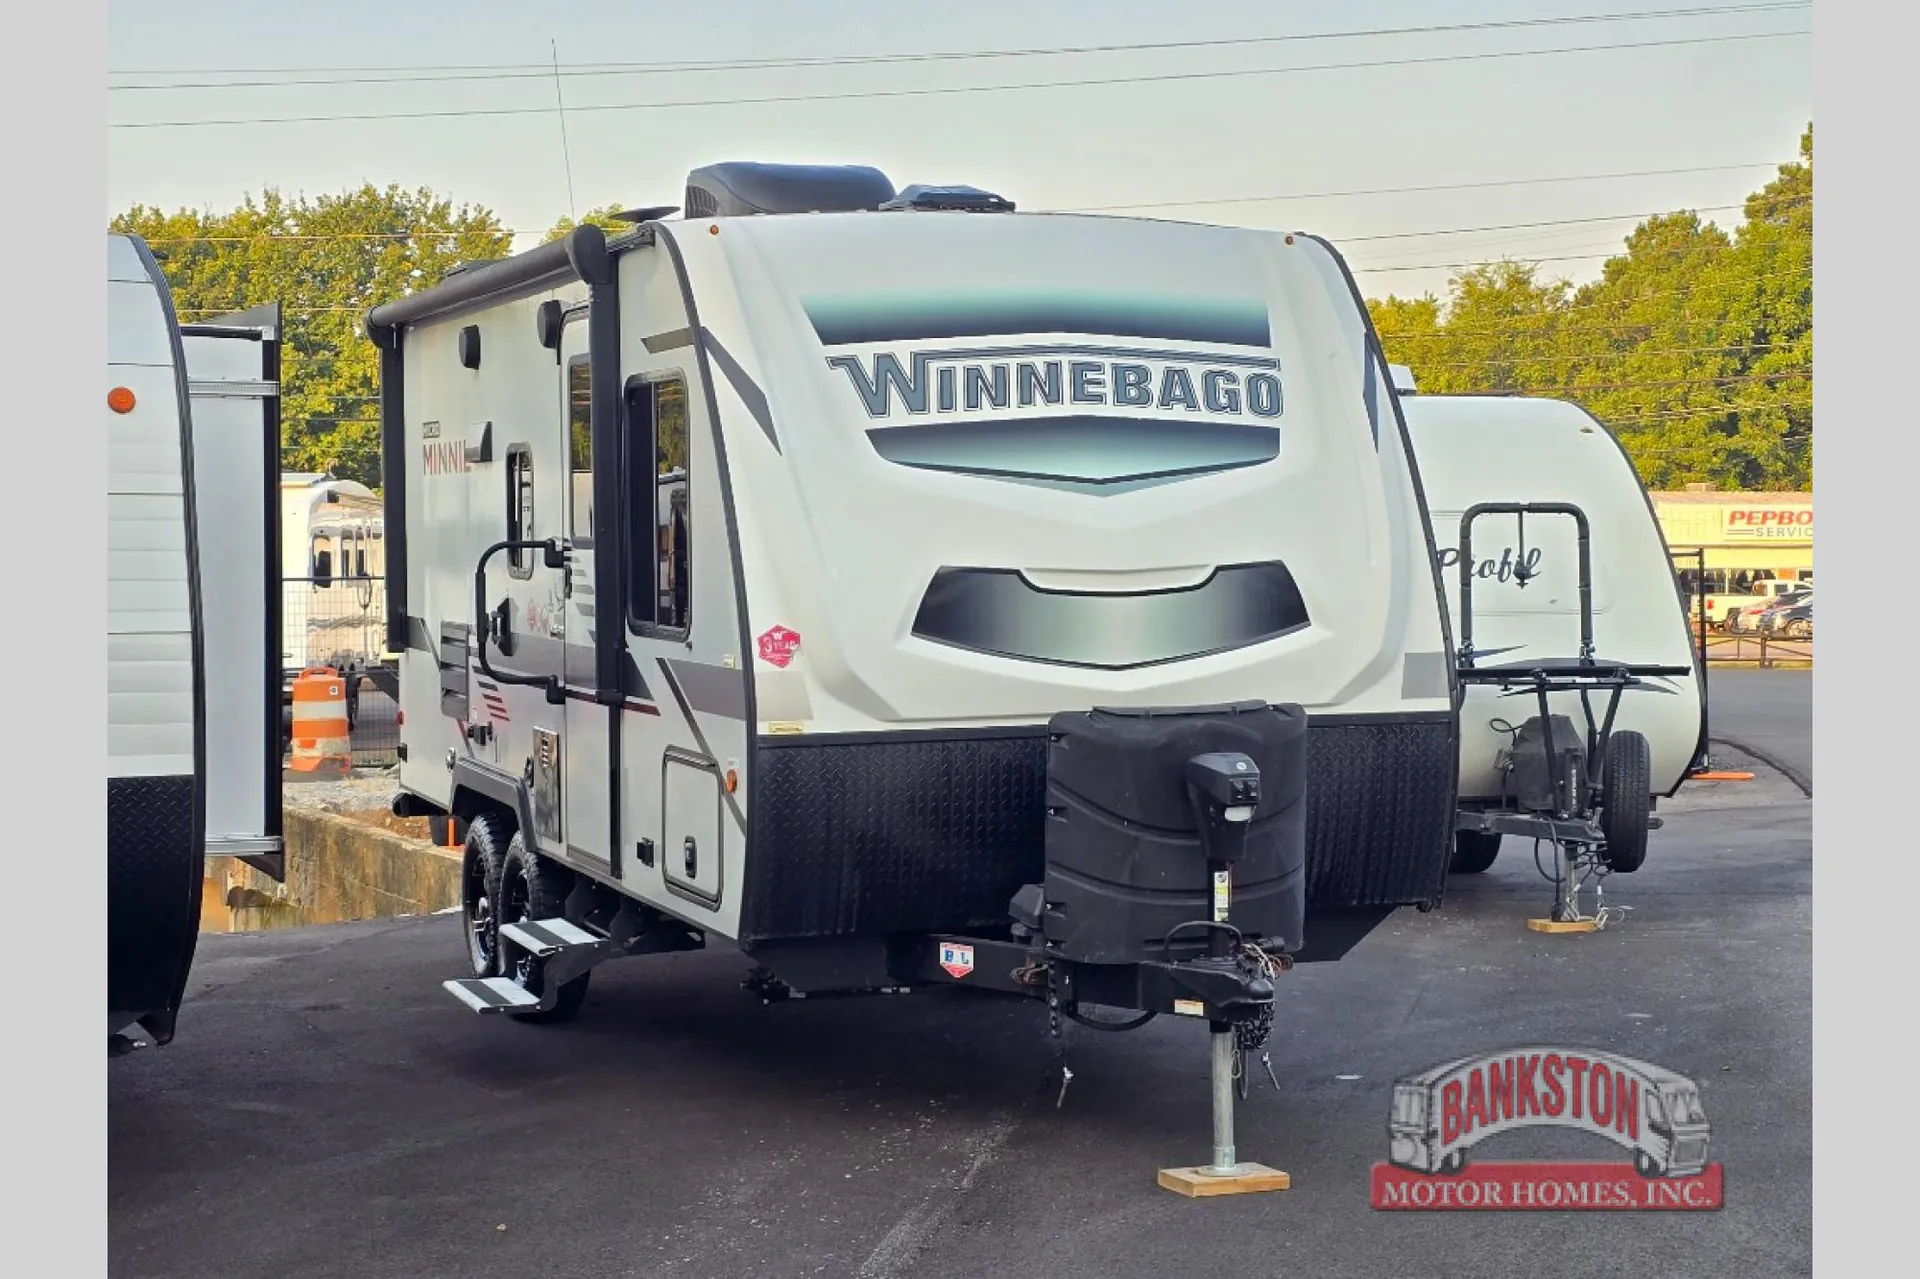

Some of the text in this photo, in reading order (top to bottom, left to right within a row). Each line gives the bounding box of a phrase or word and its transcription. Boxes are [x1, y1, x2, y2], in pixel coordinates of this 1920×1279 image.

[825, 343, 1284, 418] WINNEBAGO
[1728, 510, 1813, 525] PEPBO
[1755, 528, 1813, 537] SERVIC
